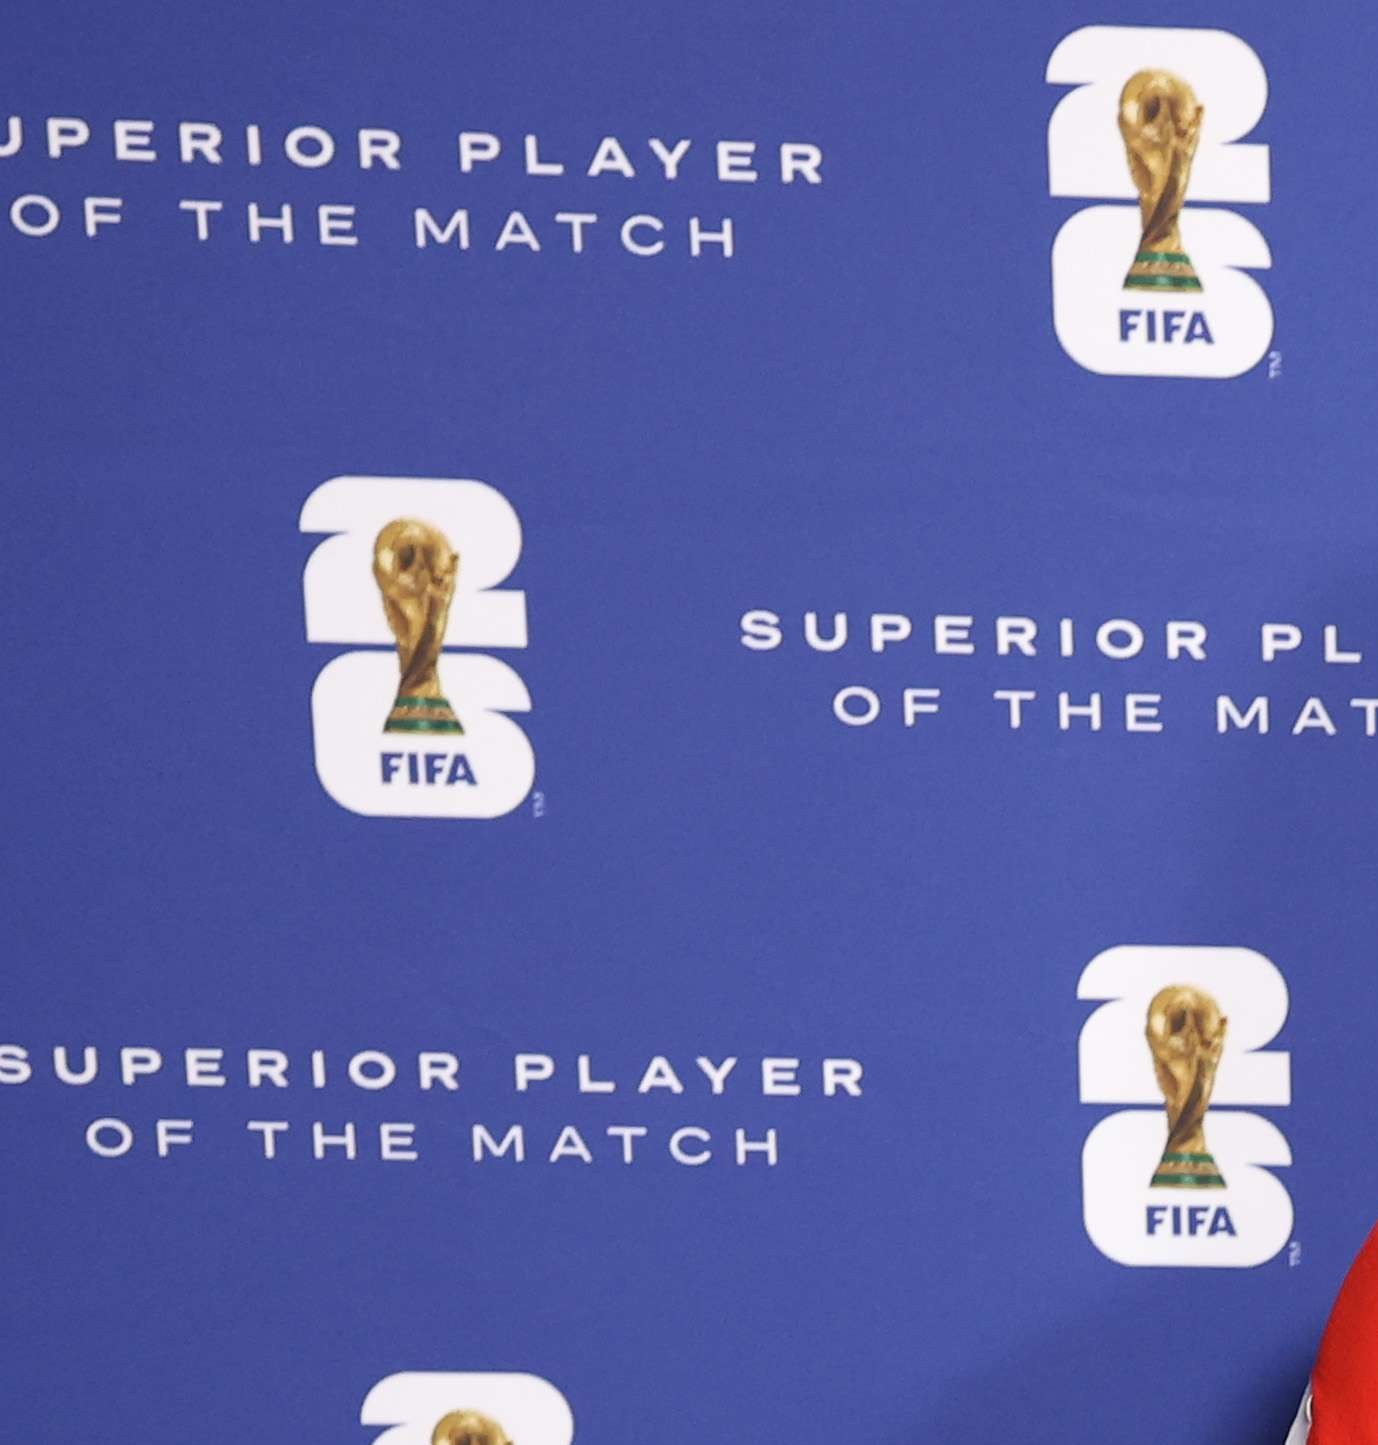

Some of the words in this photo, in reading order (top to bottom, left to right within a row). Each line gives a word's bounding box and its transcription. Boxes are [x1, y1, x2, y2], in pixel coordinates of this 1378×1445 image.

[0, 117, 399, 169] UPERIOR
[460, 133, 821, 183] PLAYER
[11, 195, 122, 236] OF
[180, 201, 357, 245] THE
[415, 209, 732, 257] MATCH
[1119, 309, 1214, 345] FIFA
[741, 611, 1206, 659] SUPERIOR
[834, 687, 939, 726] OF
[994, 691, 1162, 731] THE
[380, 751, 478, 786] FIFA
[0, 1044, 458, 1089] SUPERIOR
[516, 1054, 862, 1096] PLAYER
[87, 1118, 193, 1156] OF
[248, 1122, 417, 1160] THE
[473, 1125, 776, 1165] MATCH
[1146, 1205, 1237, 1237] FIFA
